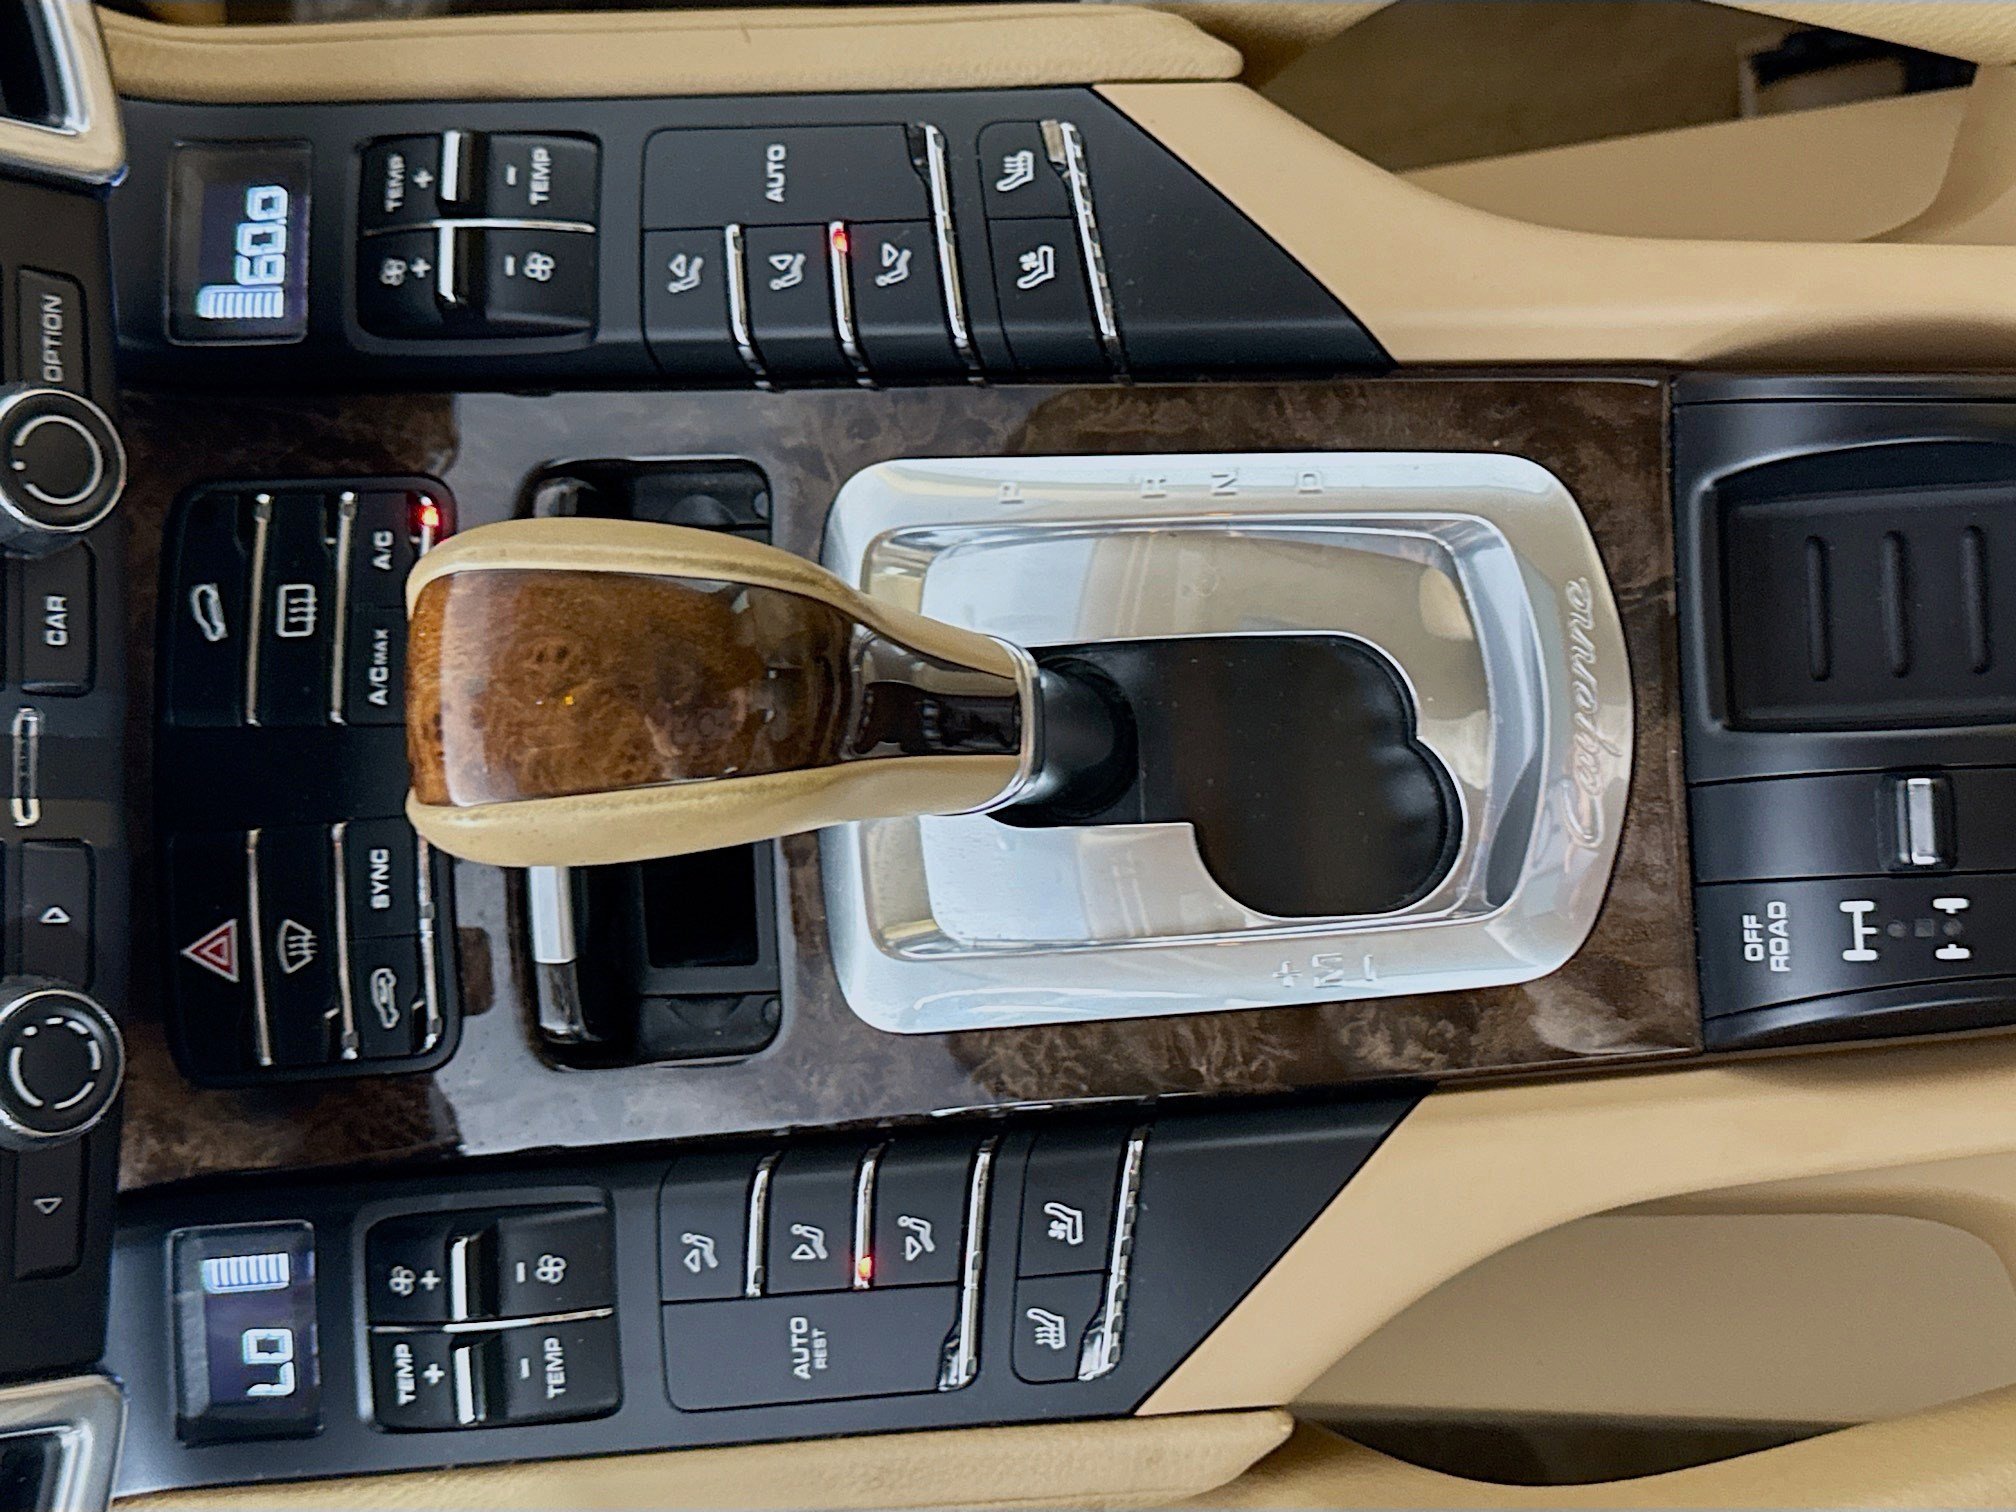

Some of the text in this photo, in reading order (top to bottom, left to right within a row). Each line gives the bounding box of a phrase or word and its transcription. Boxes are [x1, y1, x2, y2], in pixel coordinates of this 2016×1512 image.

[384, 153, 405, 212] TEMP
[530, 148, 551, 205] TEMP
[765, 144, 786, 202] AUTO
[43, 294, 63, 382] OPTION
[1210, 470, 1238, 496] N
[1298, 472, 1323, 494] D
[372, 530, 394, 570] A/C
[45, 595, 68, 646] CAR
[1561, 577, 1622, 848] Cayenne
[370, 848, 390, 909] SYNC
[1742, 914, 1765, 962] OFF
[1766, 901, 1792, 972] ROAD
[395, 1343, 416, 1405] TEMP
[544, 1337, 566, 1399] TEMP
[789, 1316, 812, 1380] AUTO
[812, 1328, 828, 1370] REST
